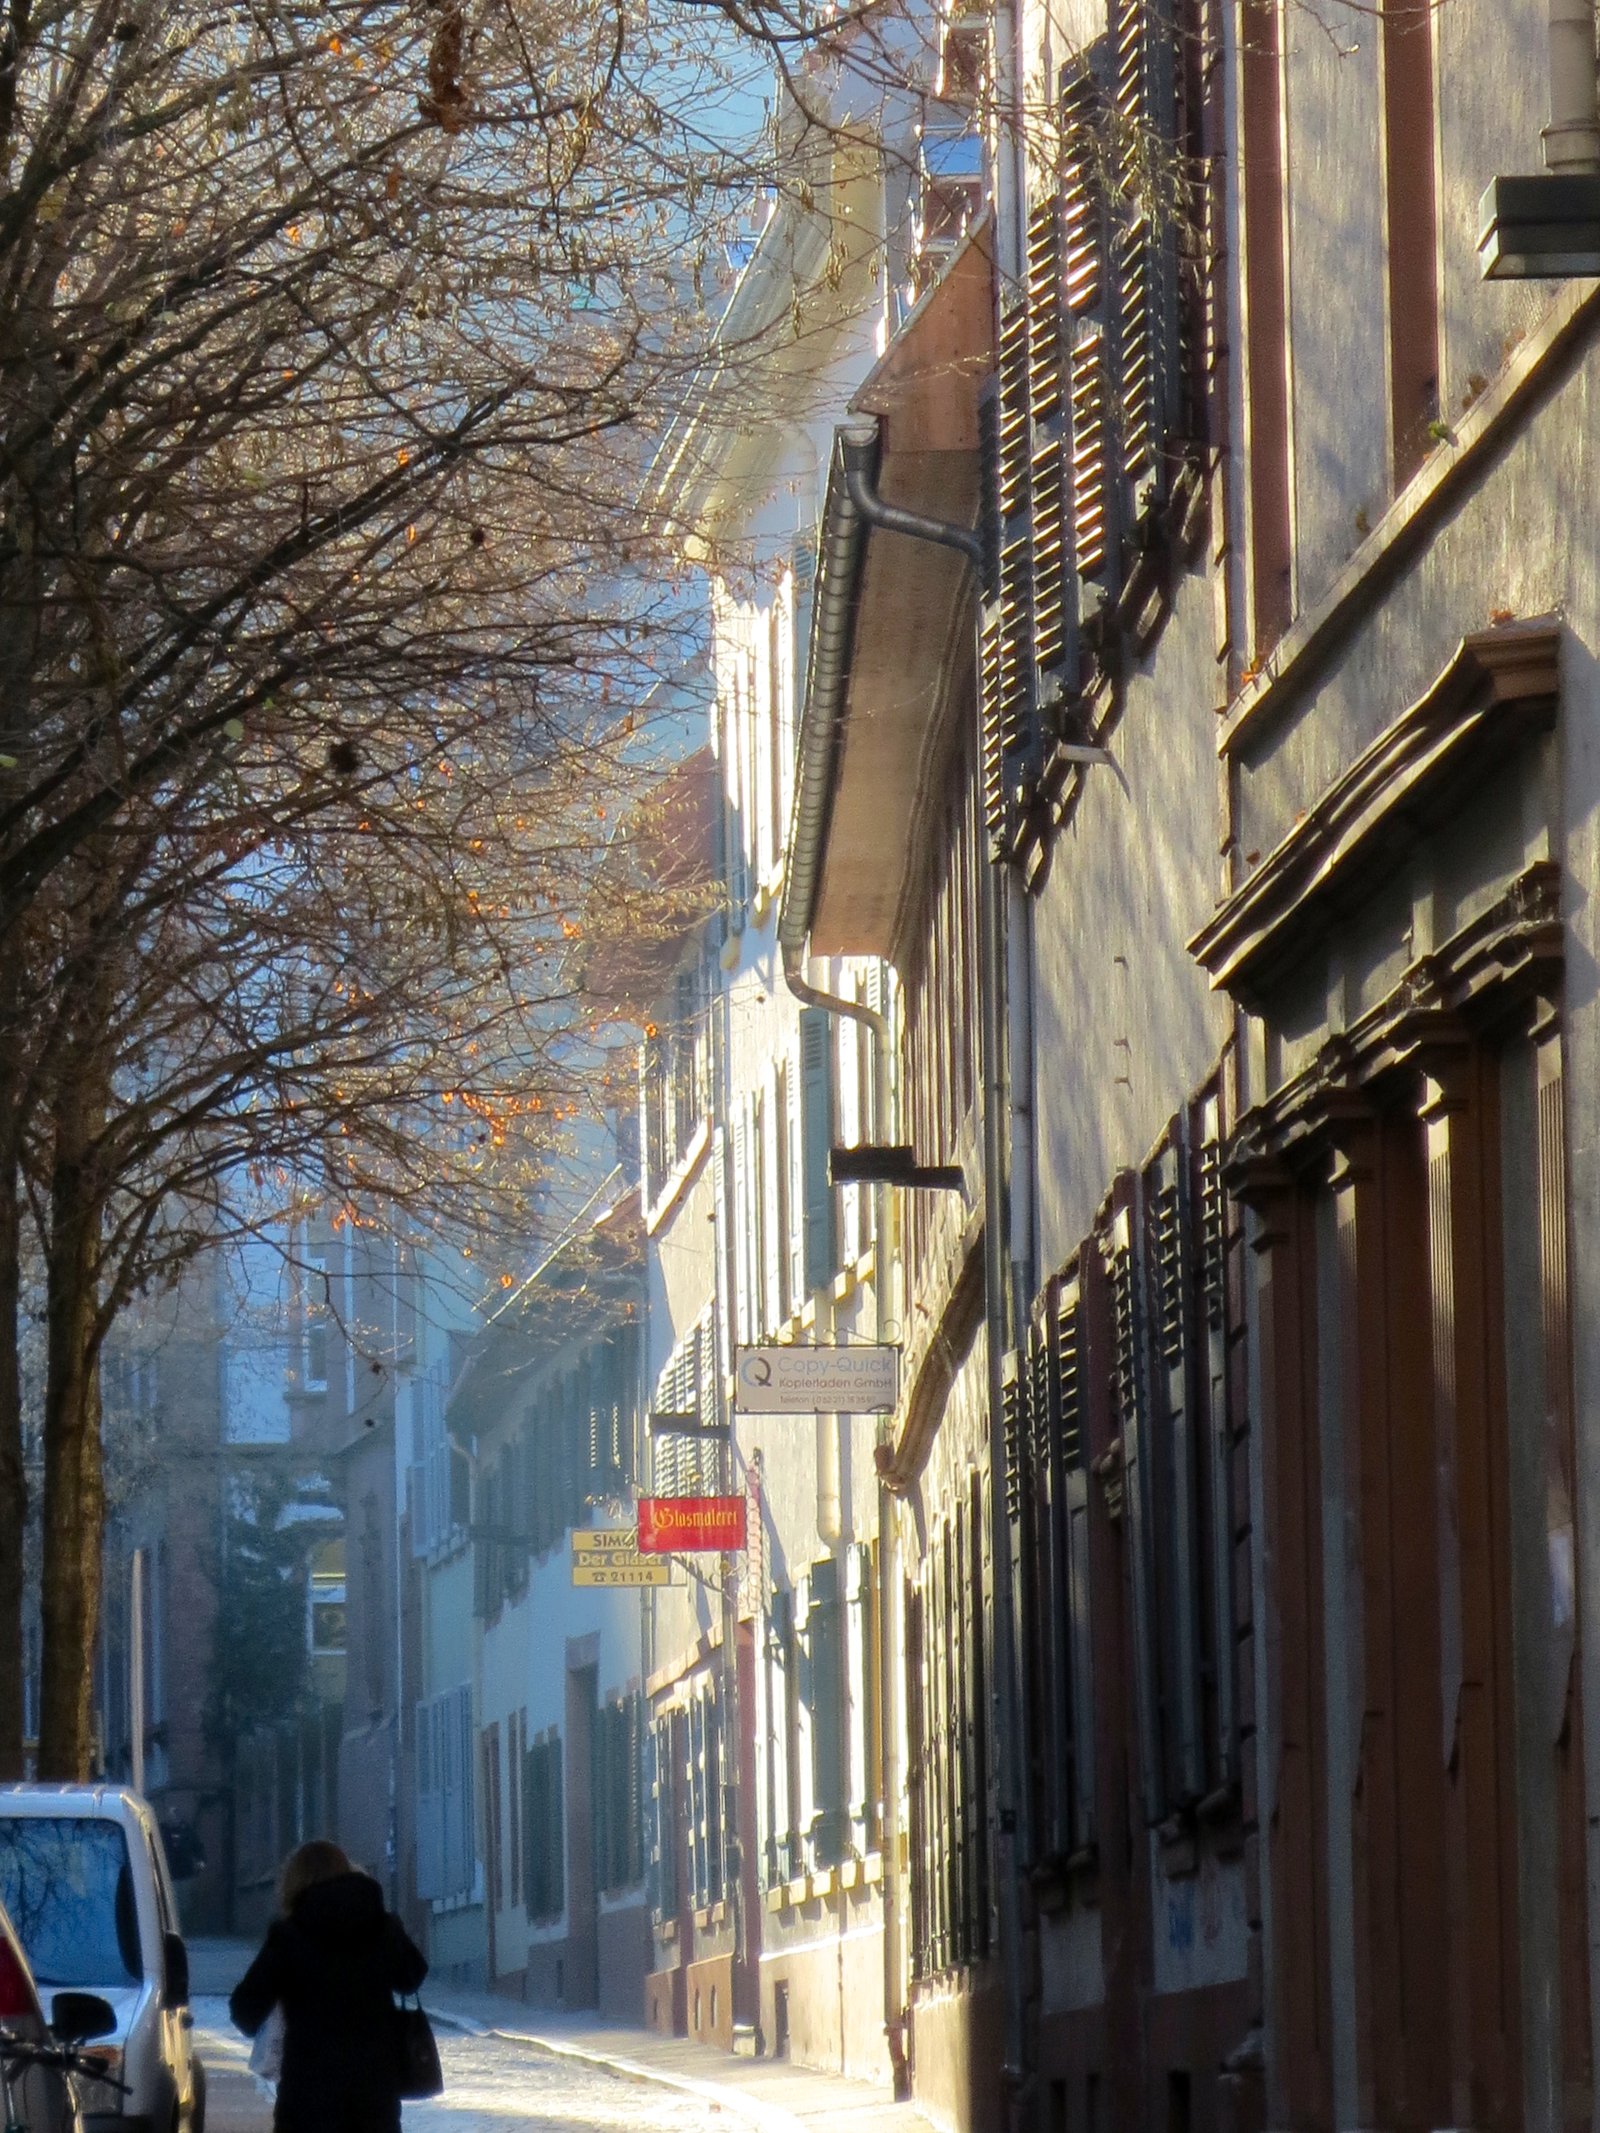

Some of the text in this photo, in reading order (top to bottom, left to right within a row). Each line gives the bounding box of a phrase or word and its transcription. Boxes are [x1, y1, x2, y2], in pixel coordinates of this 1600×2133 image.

[777, 1356, 891, 1375] Copy-Quick
[779, 1377, 891, 1389] Kopierladen GmbH
[654, 1508, 737, 1529] Glasmalerei
[593, 1534, 635, 1547] SIMO
[578, 1551, 662, 1566] Der Glaser
[610, 1571, 653, 1582] 21114
